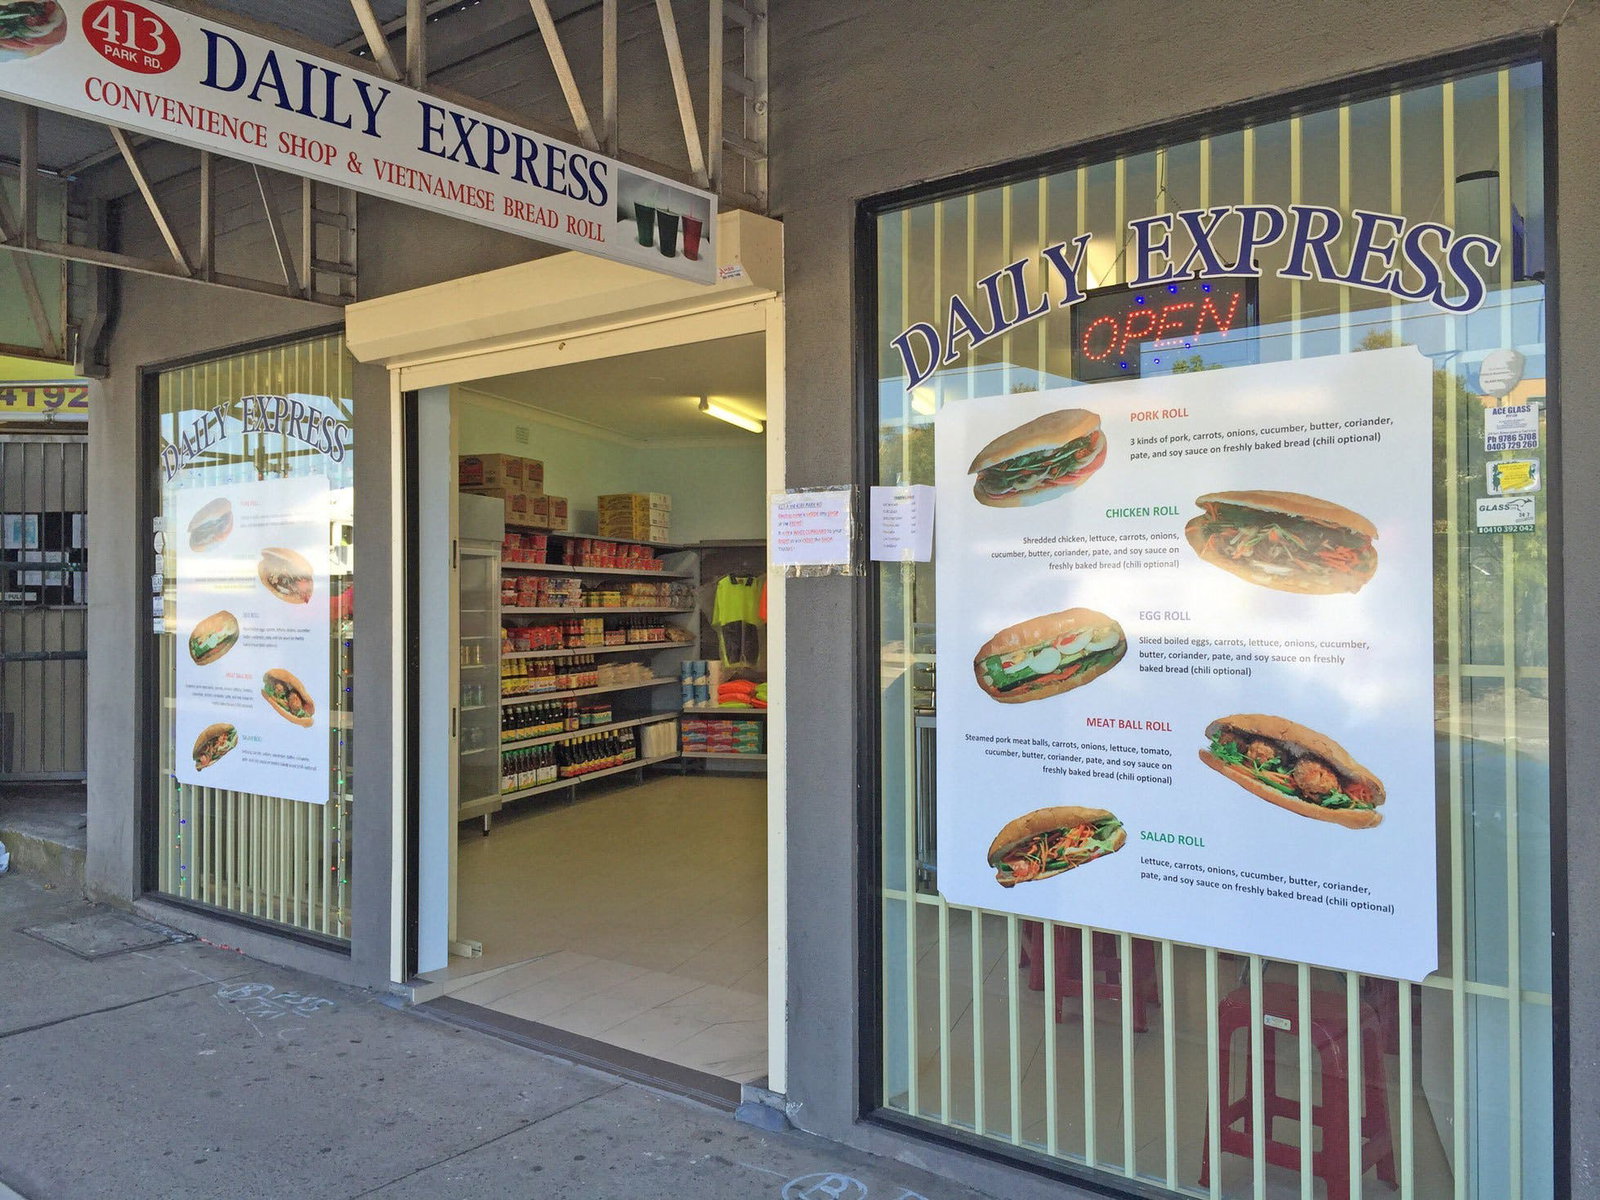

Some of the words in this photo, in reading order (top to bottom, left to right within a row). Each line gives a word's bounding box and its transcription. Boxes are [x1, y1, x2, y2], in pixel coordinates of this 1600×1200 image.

[92, 5, 166, 56] 413
[104, 45, 137, 63] PARK
[144, 56, 163, 70] RD.
[200, 28, 390, 138] DAILY
[418, 100, 608, 207] EXPRESS
[85, 77, 267, 148] CONVENIENCE
[278, 131, 338, 166] SHOP
[348, 152, 363, 175] &
[374, 158, 495, 212] VIETNAMESE
[504, 197, 558, 229] BREAD
[566, 216, 605, 243] ROLL
[890, 233, 1092, 391] DAILY
[1128, 204, 1501, 314] EXPRESS
[1084, 293, 1239, 360] OPEN
[1130, 410, 1159, 422] PORK
[1162, 408, 1189, 420] ROLL
[1492, 407, 1506, 415] ACE
[1508, 405, 1531, 413] GLASS
[162, 401, 230, 482] DAILY
[241, 394, 349, 464] EXPRESS
[1130, 438, 1135, 446] 3
[1136, 435, 1157, 445] kinds
[1159, 434, 1168, 443] of
[1170, 433, 1191, 444] pork,
[1193, 430, 1224, 441] carrots,
[1227, 428, 1258, 438] onions,
[1260, 424, 1307, 435] cucumber,
[1310, 421, 1342, 431] butter,
[1344, 416, 1393, 428] coriander,
[1498, 434, 1517, 442] 9786
[1518, 433, 1537, 441] 5708
[1130, 451, 1151, 461] pate,
[1152, 448, 1167, 458] and
[1169, 449, 1184, 459] soy
[1185, 447, 1208, 456] sauce
[1210, 446, 1221, 454] on
[1223, 442, 1252, 453] freshly
[1254, 439, 1282, 450] baked
[1284, 437, 1310, 448] bread
[1312, 434, 1335, 448] (chili
[1337, 432, 1381, 445] optional)
[1487, 442, 1506, 451] 0403
[1507, 441, 1521, 450] 729
[1522, 440, 1537, 449] 260
[1106, 508, 1150, 518] CHICKEN
[1153, 506, 1179, 516] ROLL
[1479, 504, 1510, 512] GLASS
[1023, 535, 1056, 545] Shredded
[1058, 534, 1087, 544] chicken,
[1089, 534, 1117, 543] lettuce,
[1119, 533, 1148, 542] carrots,
[1150, 532, 1179, 541] onions,
[991, 550, 1027, 559] cucumber,
[1028, 549, 1052, 558] butter,
[1054, 548, 1090, 557] coriander,
[1092, 548, 1111, 557] pate,
[1113, 547, 1128, 555] and
[1129, 548, 1143, 556] soy
[1049, 562, 1073, 571] freshly
[1075, 562, 1098, 570] baked
[1099, 561, 1121, 569] bread
[1123, 561, 1142, 570] (chili
[1143, 560, 1180, 569] optional)
[1139, 611, 1162, 621] EGG
[1164, 612, 1191, 621] ROLL
[1139, 636, 1162, 645] Sliced
[1164, 637, 1189, 646] boiled
[1191, 638, 1212, 648] eggs,
[1214, 638, 1246, 647] carrots,
[1249, 638, 1282, 648] lettuce,
[1284, 639, 1318, 649] onions,
[1320, 640, 1370, 650] cucumber,
[1139, 650, 1167, 660] butter,
[1168, 651, 1210, 661] coriander,
[1212, 653, 1233, 662] pate,
[1236, 652, 1252, 661] and
[1254, 655, 1269, 663] soy
[1271, 655, 1297, 663] sauce
[1299, 655, 1311, 663] on
[1313, 654, 1345, 665] freshly
[1139, 664, 1164, 673] baked
[1166, 665, 1189, 674] bread
[1191, 665, 1211, 676] (chili
[1212, 667, 1252, 677] optional)
[1087, 717, 1116, 729] MEAT
[1118, 720, 1143, 730] BALL
[1146, 721, 1172, 732] ROLL
[965, 734, 994, 743] Steamed
[996, 735, 1012, 745] pork
[1013, 737, 1031, 746] meat
[1032, 738, 1051, 748] balls,
[1052, 740, 1079, 750] carrots,
[1081, 742, 1108, 752] onions,
[1110, 743, 1139, 754] lettuce,
[1141, 746, 1172, 757] tomato,
[985, 748, 1021, 759] cucumber,
[1022, 751, 1046, 761] butter,
[1048, 753, 1084, 764] coriander,
[1086, 757, 1105, 766] pate,
[1107, 757, 1121, 766] and
[1123, 760, 1136, 769] soy
[1138, 761, 1160, 769] sauce
[1043, 765, 1067, 776] freshly
[1069, 768, 1091, 777] baked
[1093, 770, 1115, 779] bread
[1117, 771, 1135, 782] (chili
[1137, 774, 1172, 786] optional)
[1141, 831, 1175, 844] SALAD
[1178, 836, 1205, 848] ROLL
[1141, 856, 1173, 869] Lettuce,
[1174, 861, 1205, 874] carrots,
[1208, 866, 1239, 878] onions,
[1240, 870, 1287, 884] cucumber,
[1289, 876, 1321, 889] butter,
[1323, 881, 1371, 895] coriander,
[1141, 871, 1161, 882] pate,
[1163, 874, 1178, 884] and
[1180, 877, 1194, 887] soy
[1196, 879, 1220, 889] sauce
[1222, 882, 1233, 891] on
[1235, 883, 1265, 897] freshly
[1267, 887, 1294, 899] baked
[1297, 891, 1323, 904] bread
[1325, 895, 1349, 907] (chili
[1351, 899, 1395, 915] optional)
